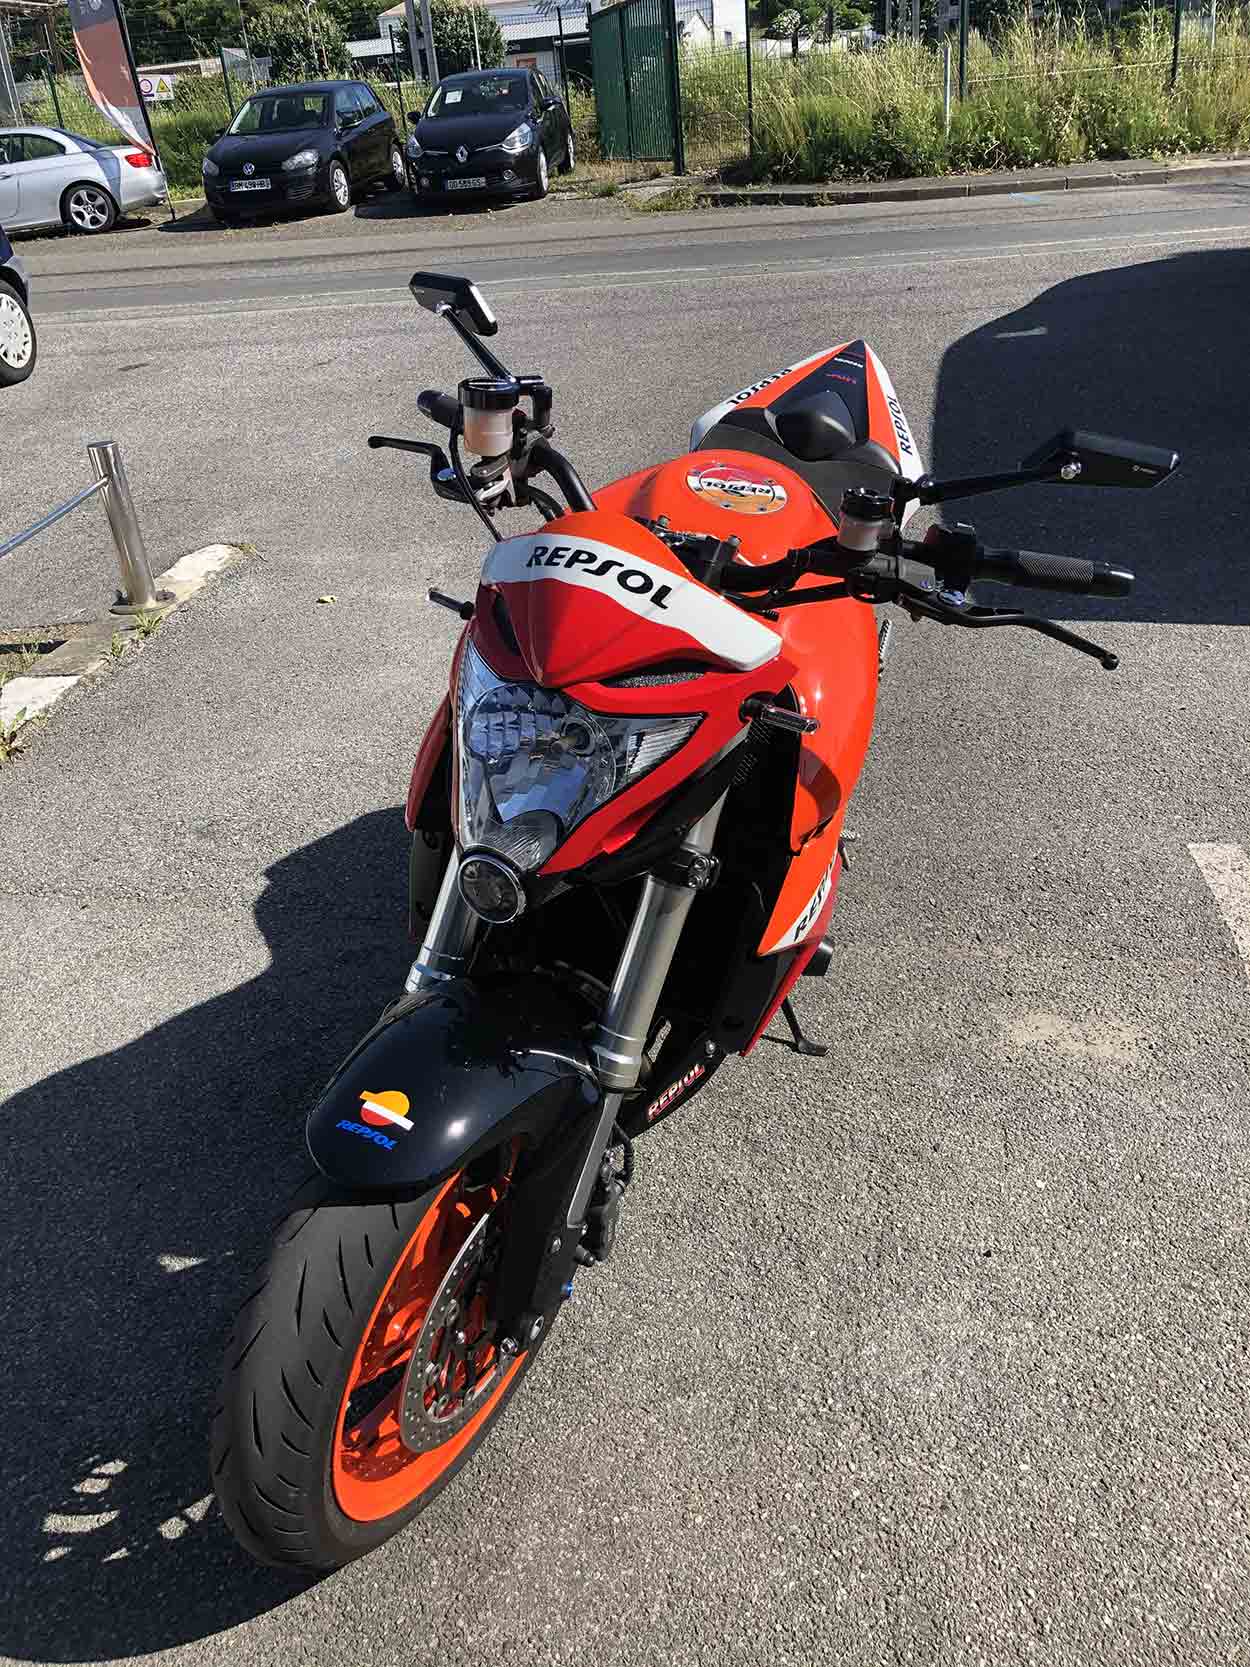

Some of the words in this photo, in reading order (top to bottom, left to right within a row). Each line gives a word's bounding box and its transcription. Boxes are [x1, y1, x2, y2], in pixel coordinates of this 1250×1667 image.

[725, 367, 793, 406] REPSOL
[887, 394, 914, 455] REPSOL
[702, 479, 772, 497] REPSOL
[526, 545, 673, 609] REPSOL
[648, 1063, 706, 1121] REPSOL
[335, 1119, 398, 1151] REPSOL
